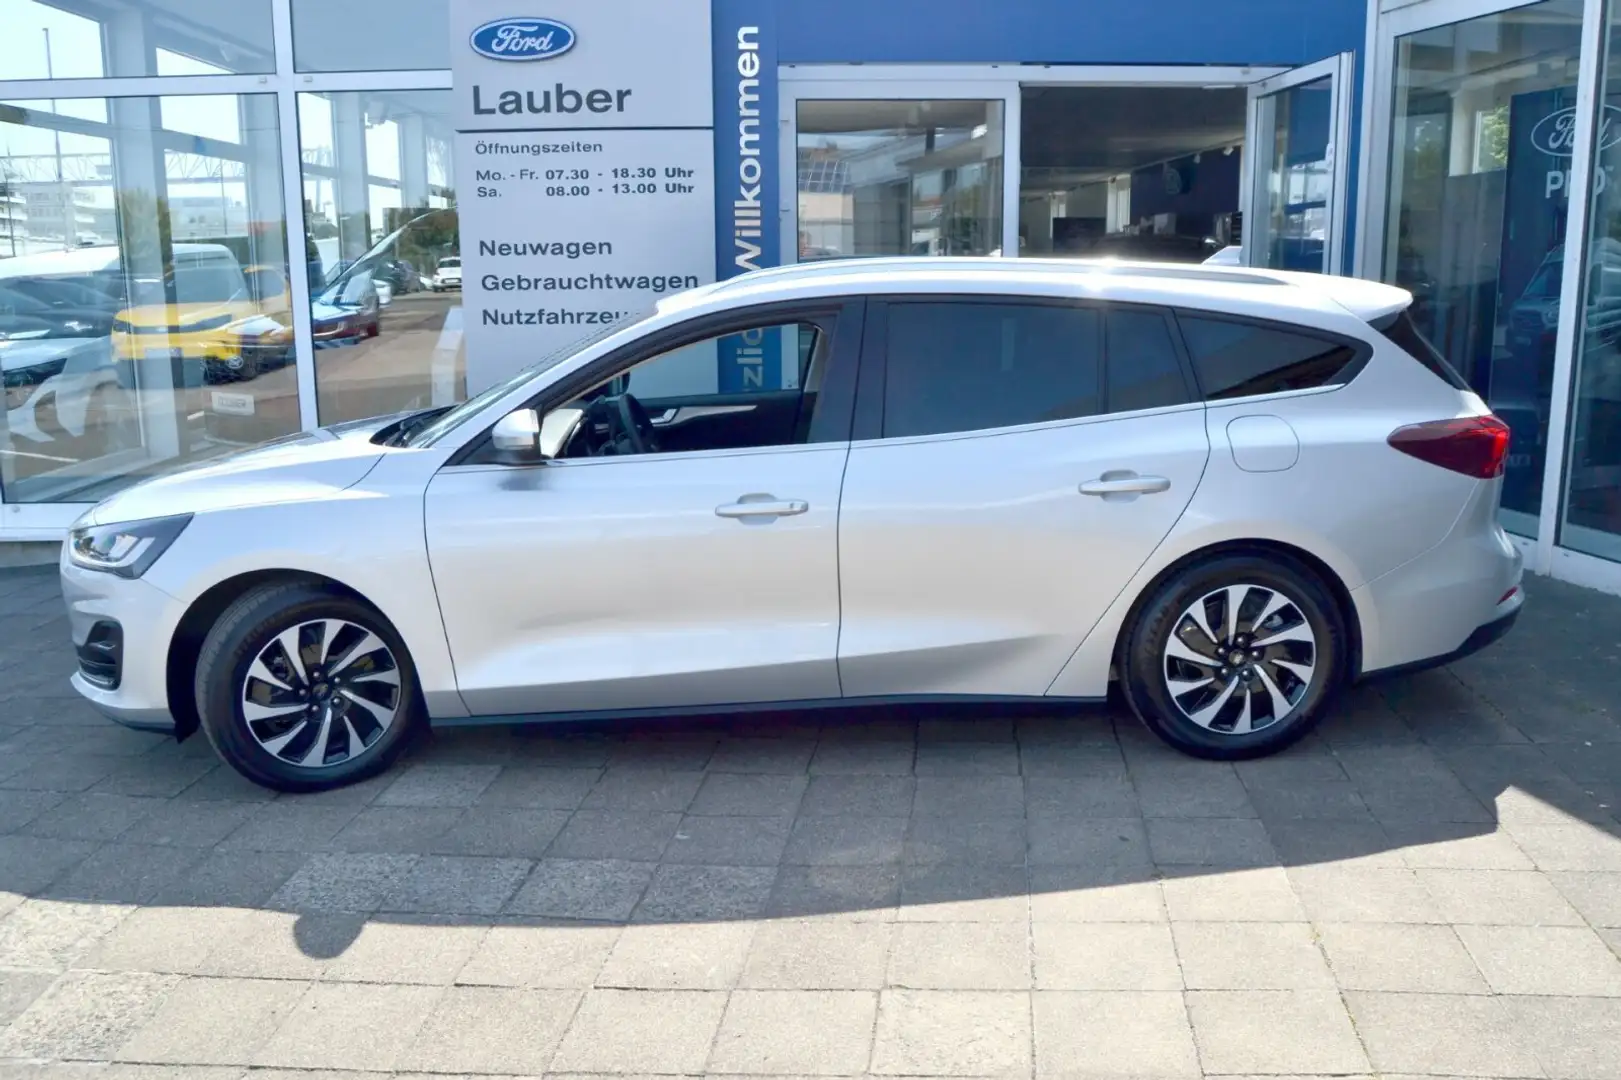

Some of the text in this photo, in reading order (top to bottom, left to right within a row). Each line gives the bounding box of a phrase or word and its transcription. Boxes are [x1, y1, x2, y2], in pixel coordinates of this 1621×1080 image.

[490, 24, 554, 53] Ford
[472, 82, 633, 116] Lauber
[474, 140, 604, 157] Öffnungszeiten
[733, 25, 763, 272] Willkommen
[475, 168, 507, 182] Mo.
[519, 168, 540, 180] Fr.
[545, 168, 590, 181] 07.30
[611, 167, 657, 179] 18.30
[664, 167, 695, 179] Uhr
[476, 185, 503, 198] Sa.
[545, 185, 591, 197] 08.00
[611, 182, 657, 195] 13.00
[664, 182, 695, 194] Uhr
[478, 239, 613, 260] Neuwagen
[480, 273, 700, 293] Gebrauchtwagen
[481, 308, 628, 326] Nutzfahrze
